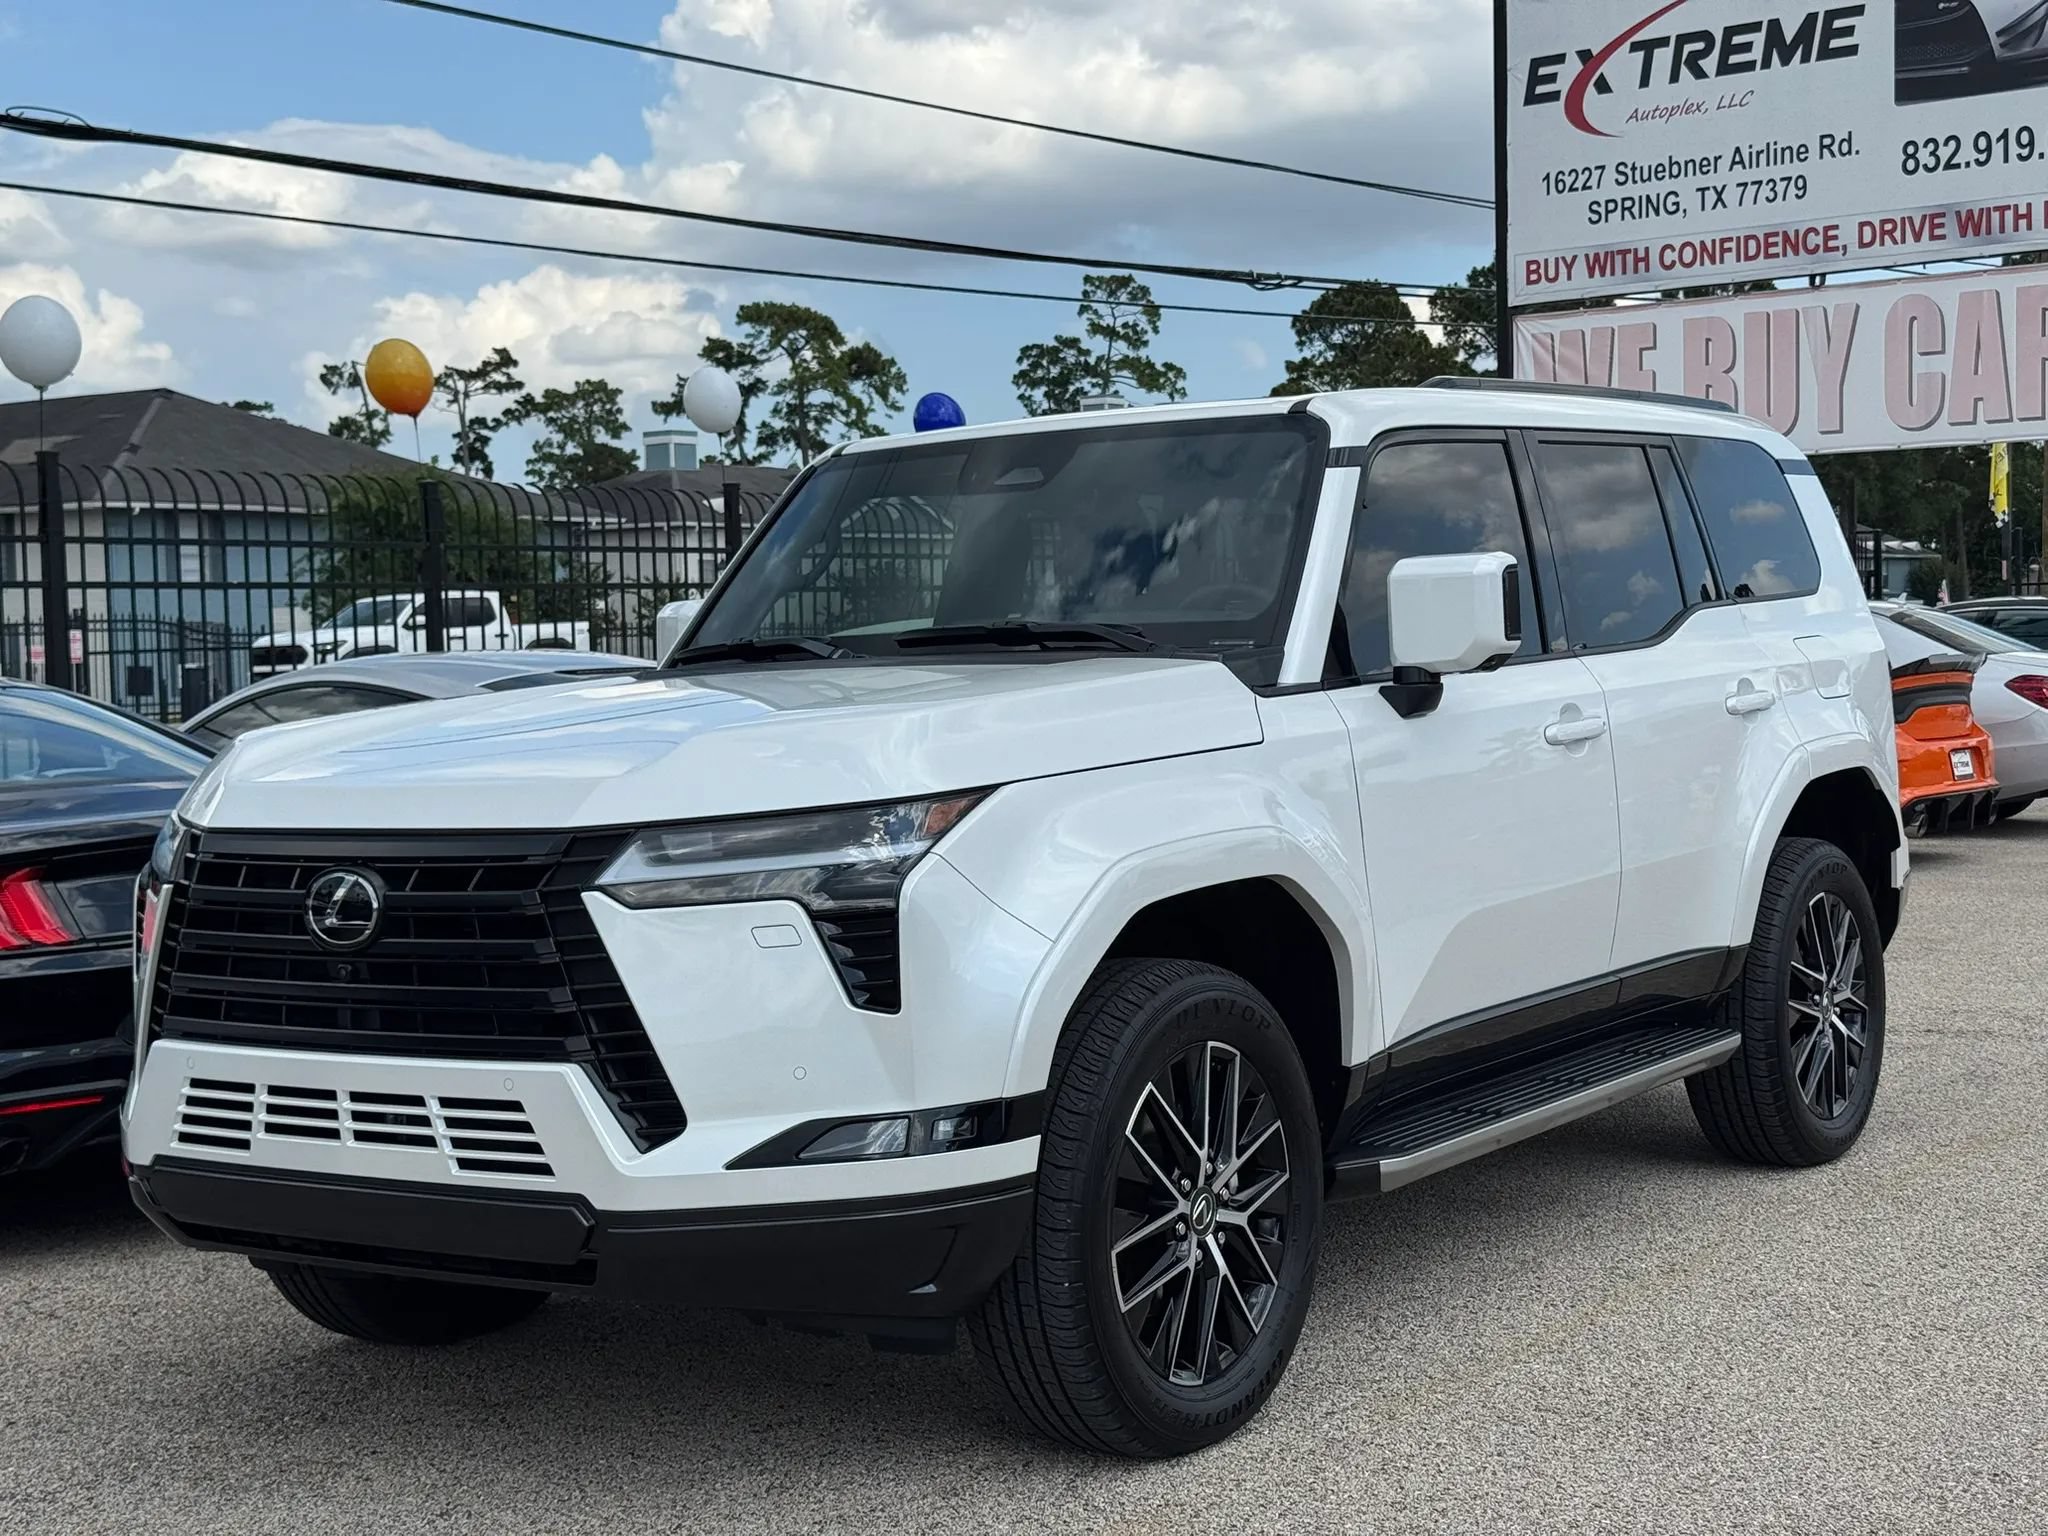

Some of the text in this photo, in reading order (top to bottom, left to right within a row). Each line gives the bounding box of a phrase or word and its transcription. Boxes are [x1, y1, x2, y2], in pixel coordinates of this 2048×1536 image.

[1523, 3, 1866, 107] EXTREME
[1625, 90, 1755, 124] Autoplex, LLC
[1541, 131, 1861, 196] 16227 Stuebner Airline Rd.
[1587, 174, 1808, 225] SPRING, TX 77379
[1525, 254, 1579, 286] BUY
[1584, 246, 1651, 279] WITH
[1658, 223, 1848, 271] CONFIDENCE,
[1857, 212, 1947, 249] DRIVE
[1955, 202, 2033, 239] WITH
[1683, 303, 1860, 437] BUY
